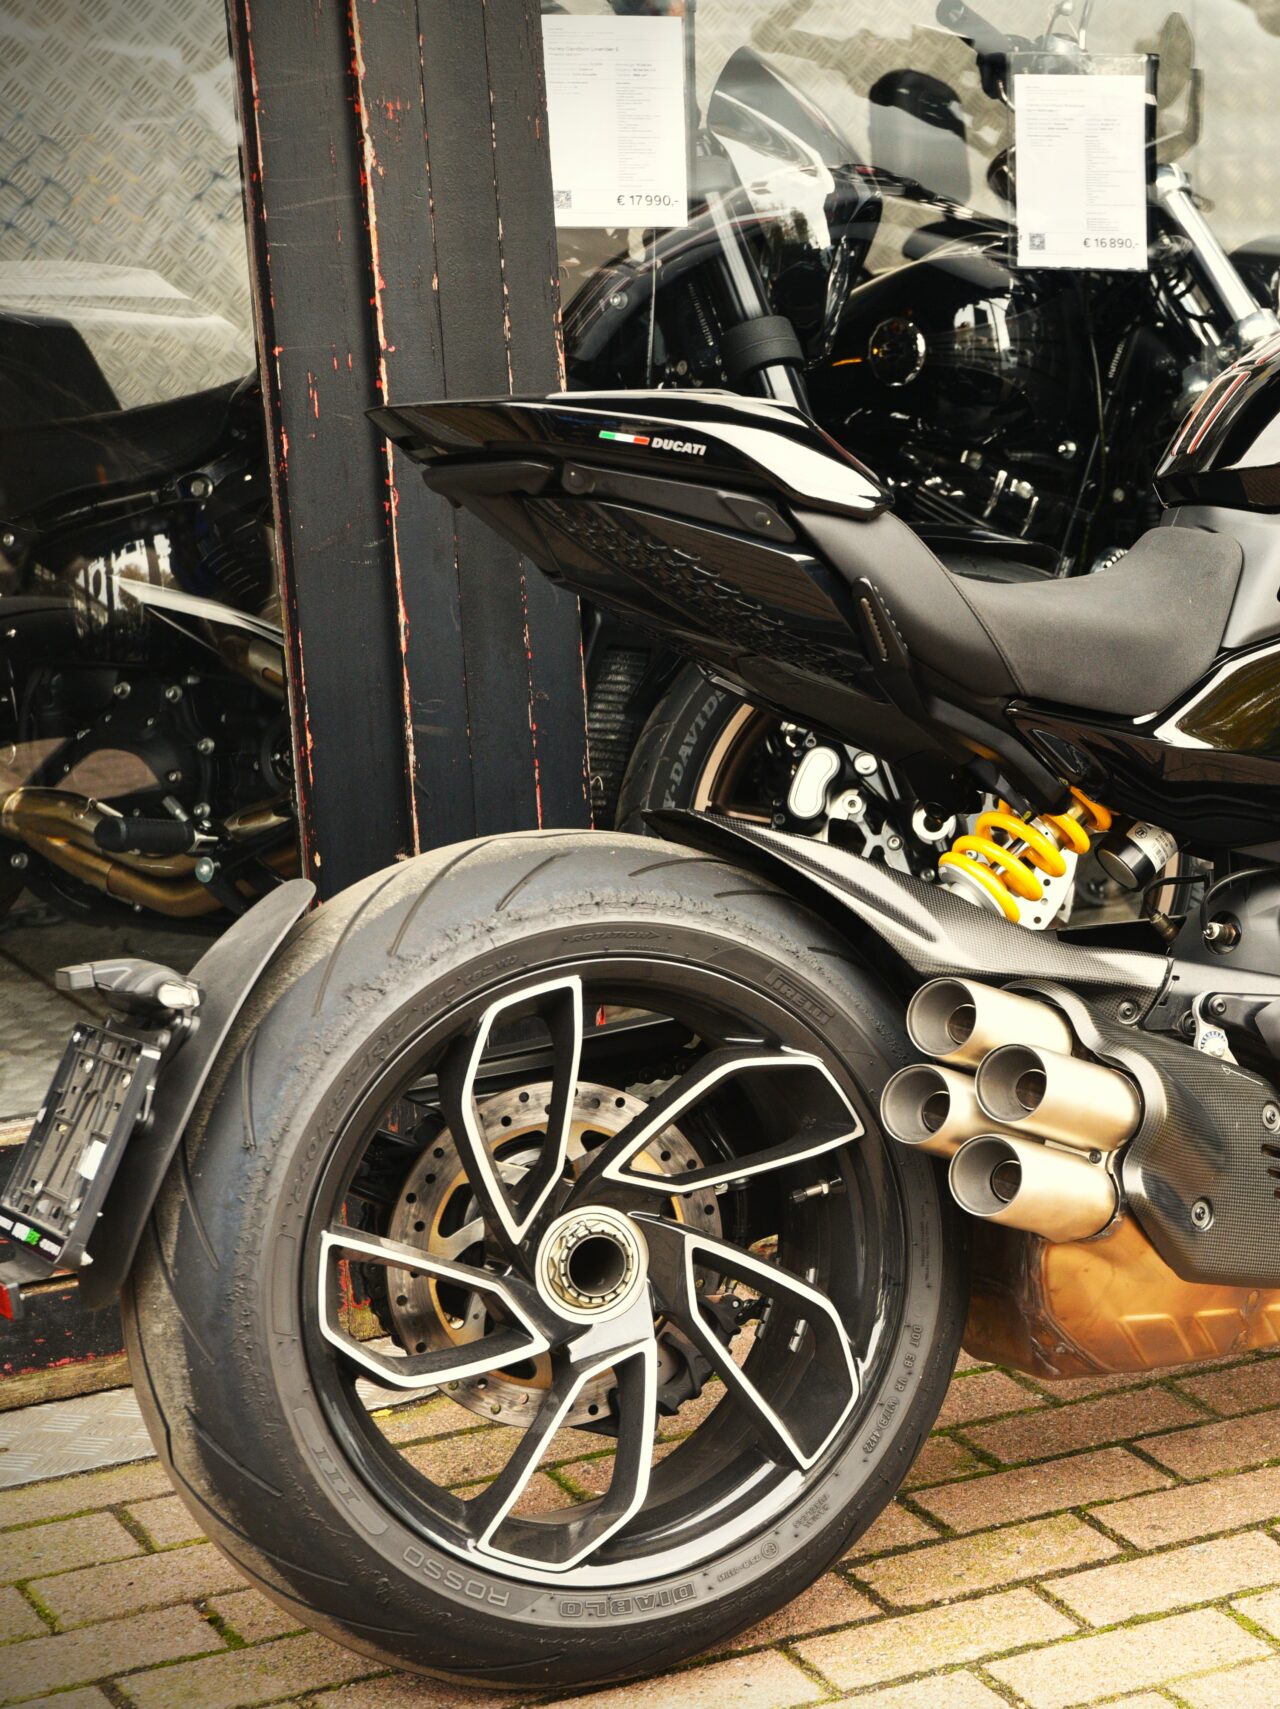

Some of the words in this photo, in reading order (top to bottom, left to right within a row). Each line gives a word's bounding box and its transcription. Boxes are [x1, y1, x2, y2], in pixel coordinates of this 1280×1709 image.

[651, 437, 707, 456] DUCATI
[568, 929, 652, 944] ROTATION
[763, 968, 836, 1026] PIRELLI
[911, 1323, 923, 1349] DOT
[402, 1544, 512, 1608] ROSSO
[558, 1581, 699, 1619] DIABLO
